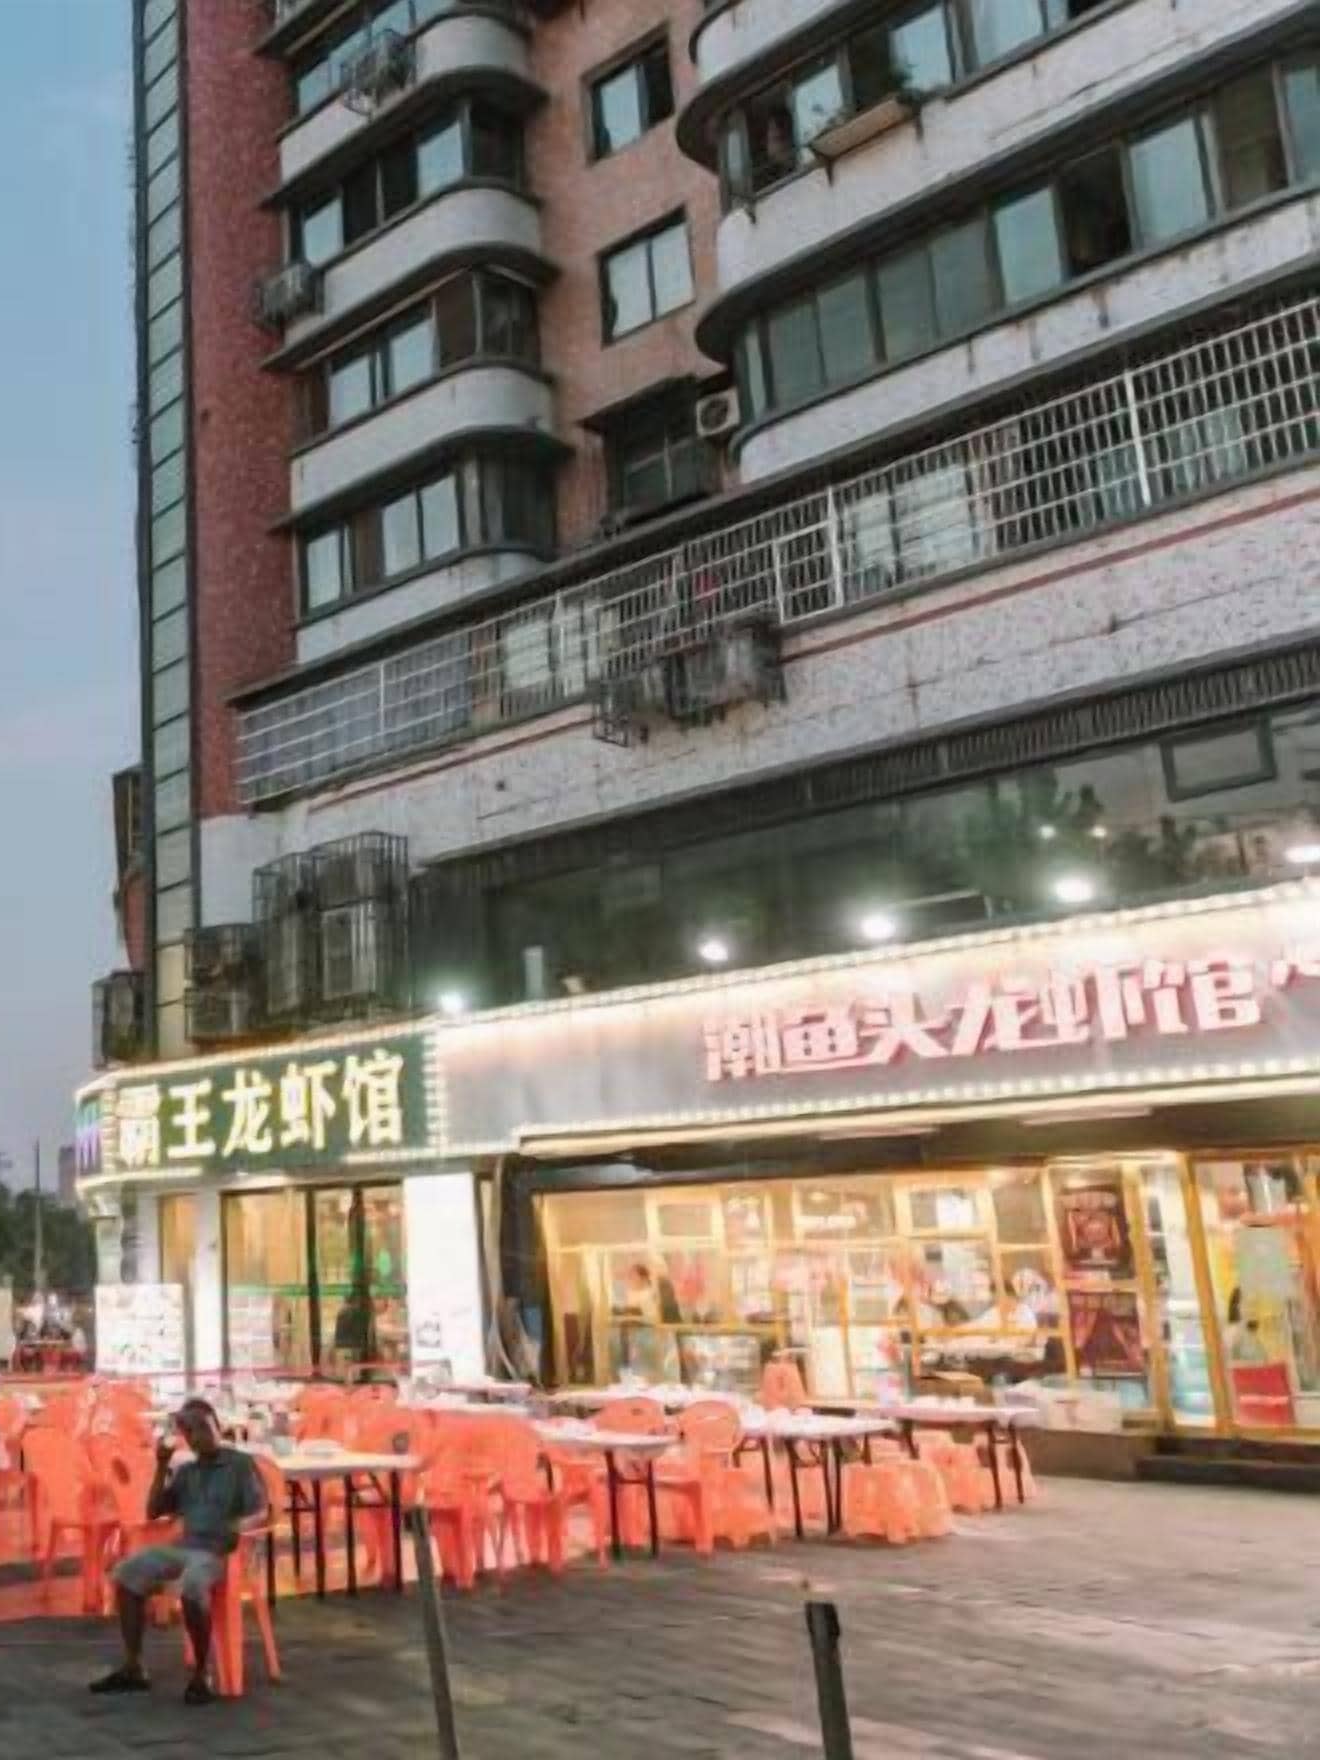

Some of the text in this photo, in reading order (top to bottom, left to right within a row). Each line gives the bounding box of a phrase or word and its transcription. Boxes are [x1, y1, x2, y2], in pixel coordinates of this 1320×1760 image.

[116, 1048, 404, 1165] 霸王龙虾馆
